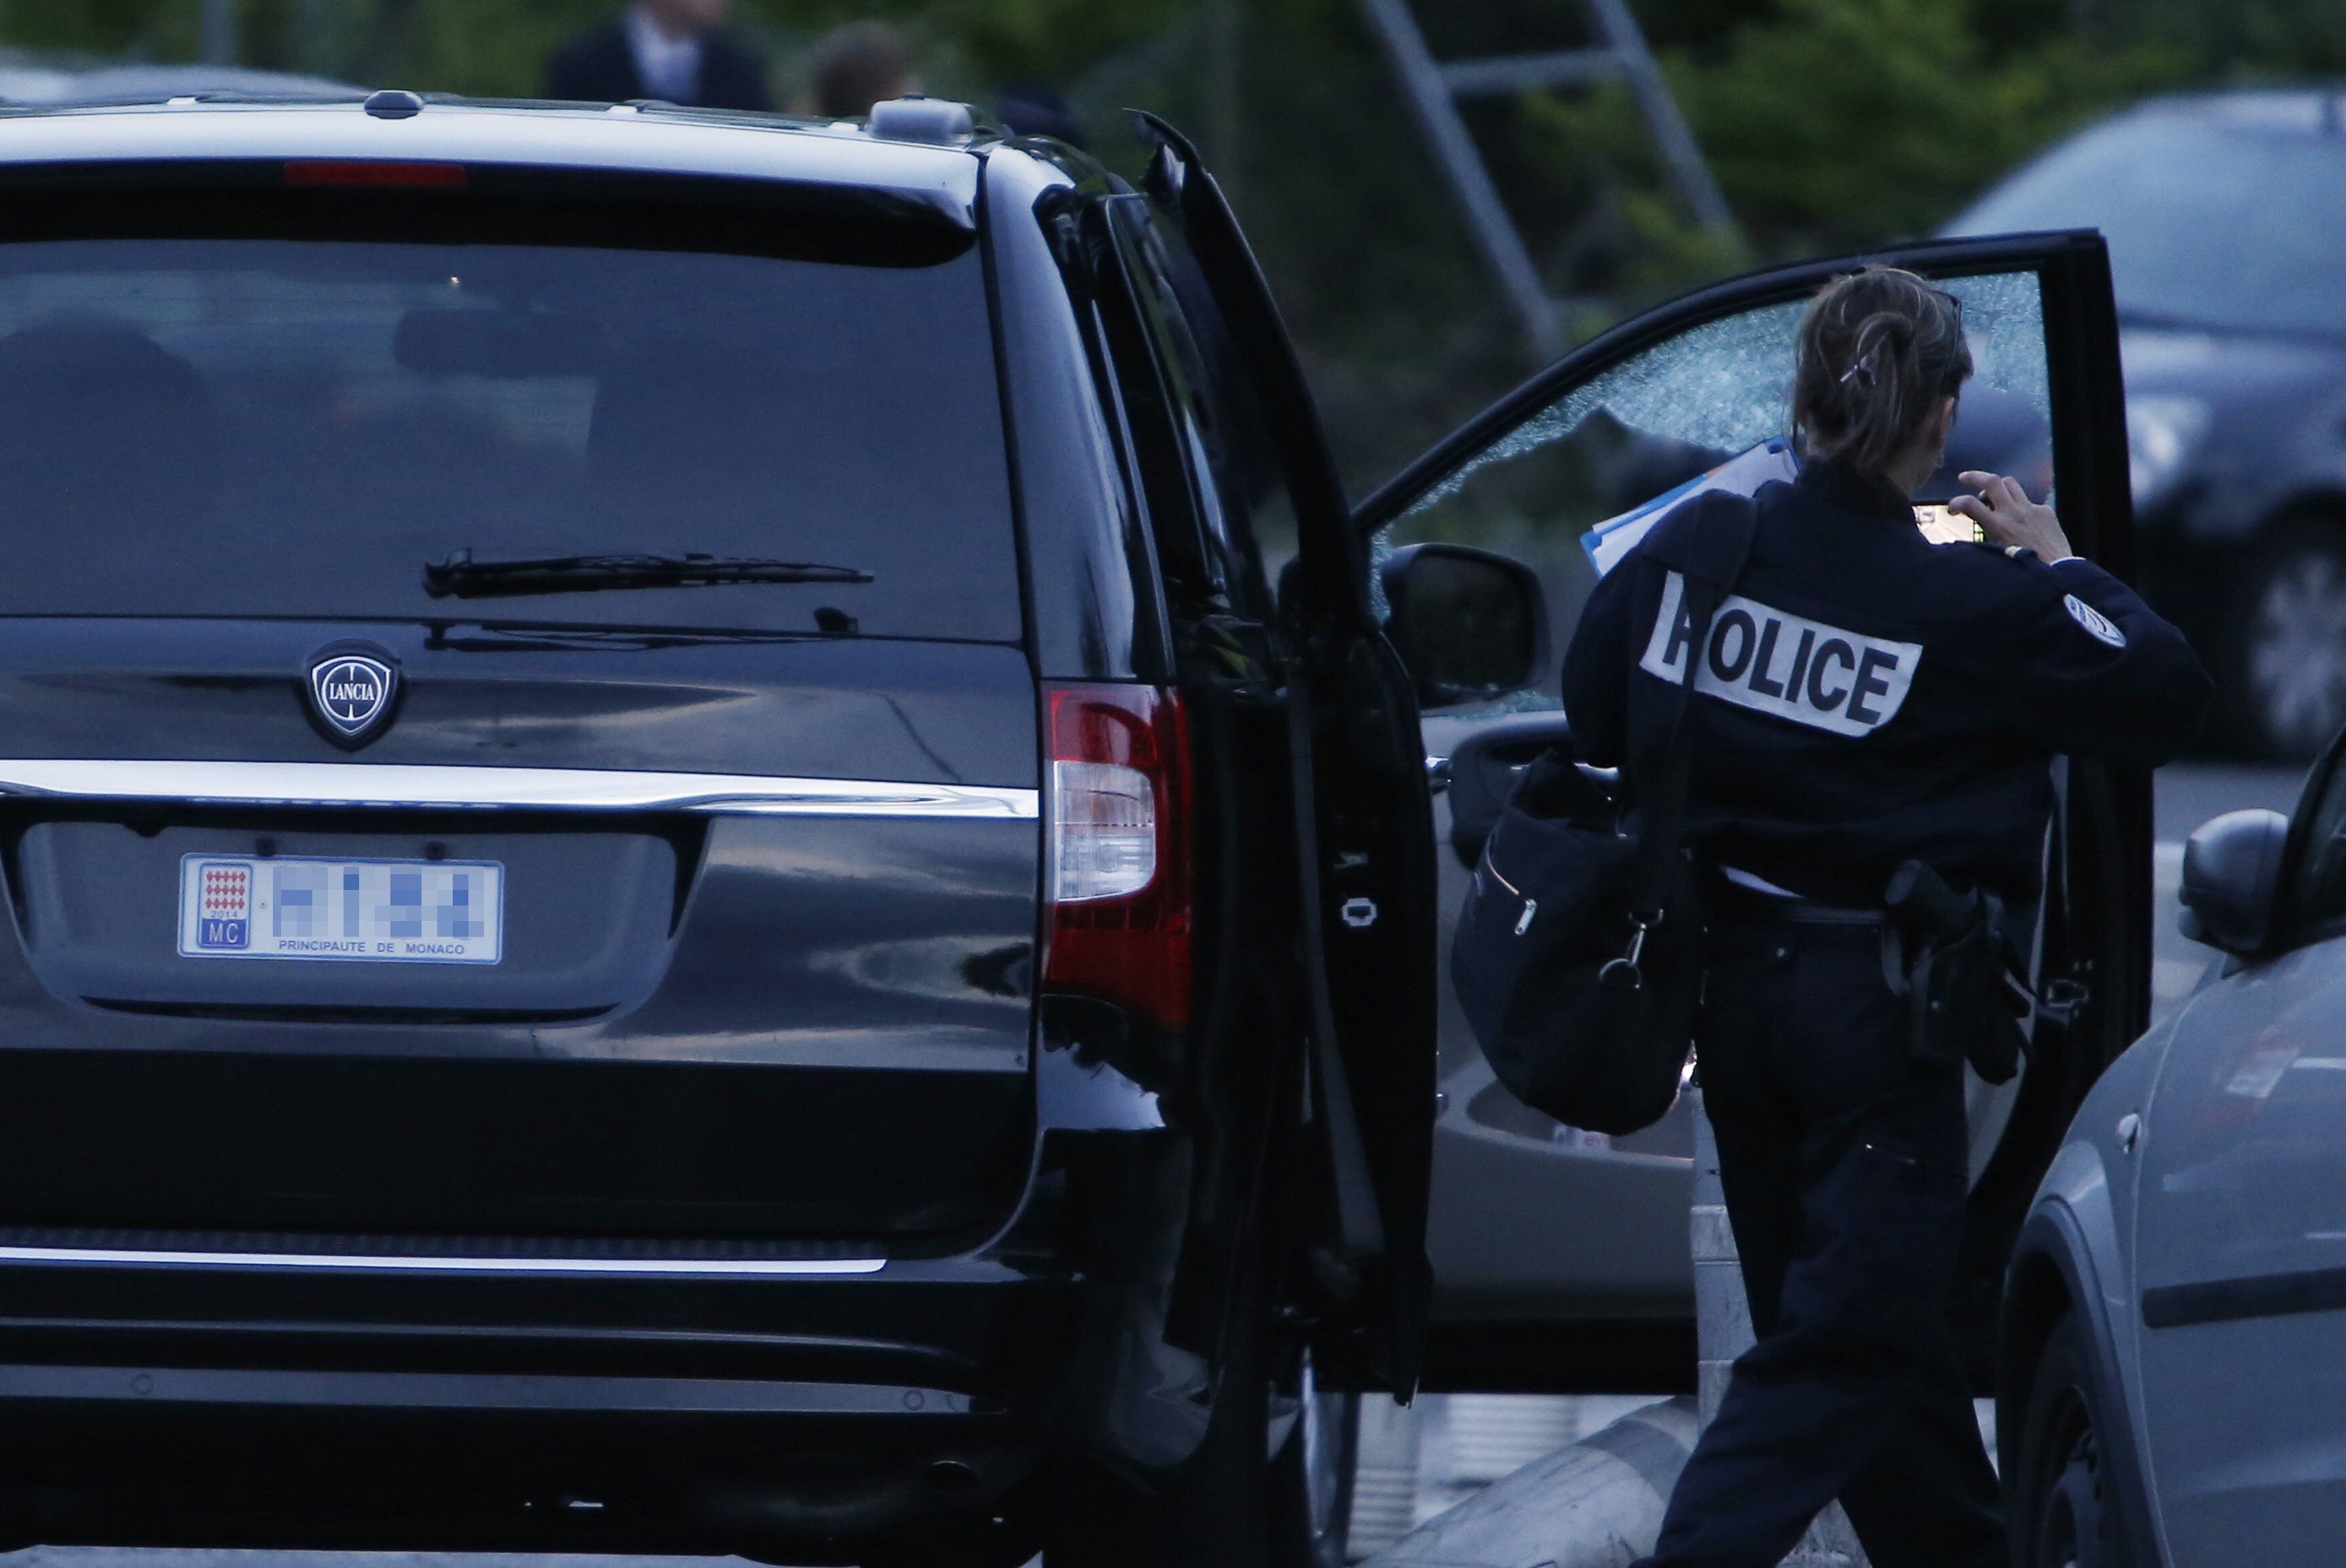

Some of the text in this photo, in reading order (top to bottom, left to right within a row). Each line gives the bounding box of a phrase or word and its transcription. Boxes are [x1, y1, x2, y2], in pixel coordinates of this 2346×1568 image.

[330, 683, 375, 701] LANCIA
[210, 910, 238, 918] 2014
[209, 922, 239, 944] MC
[279, 940, 464, 955] PRINCIPAUTE DE MONACO
